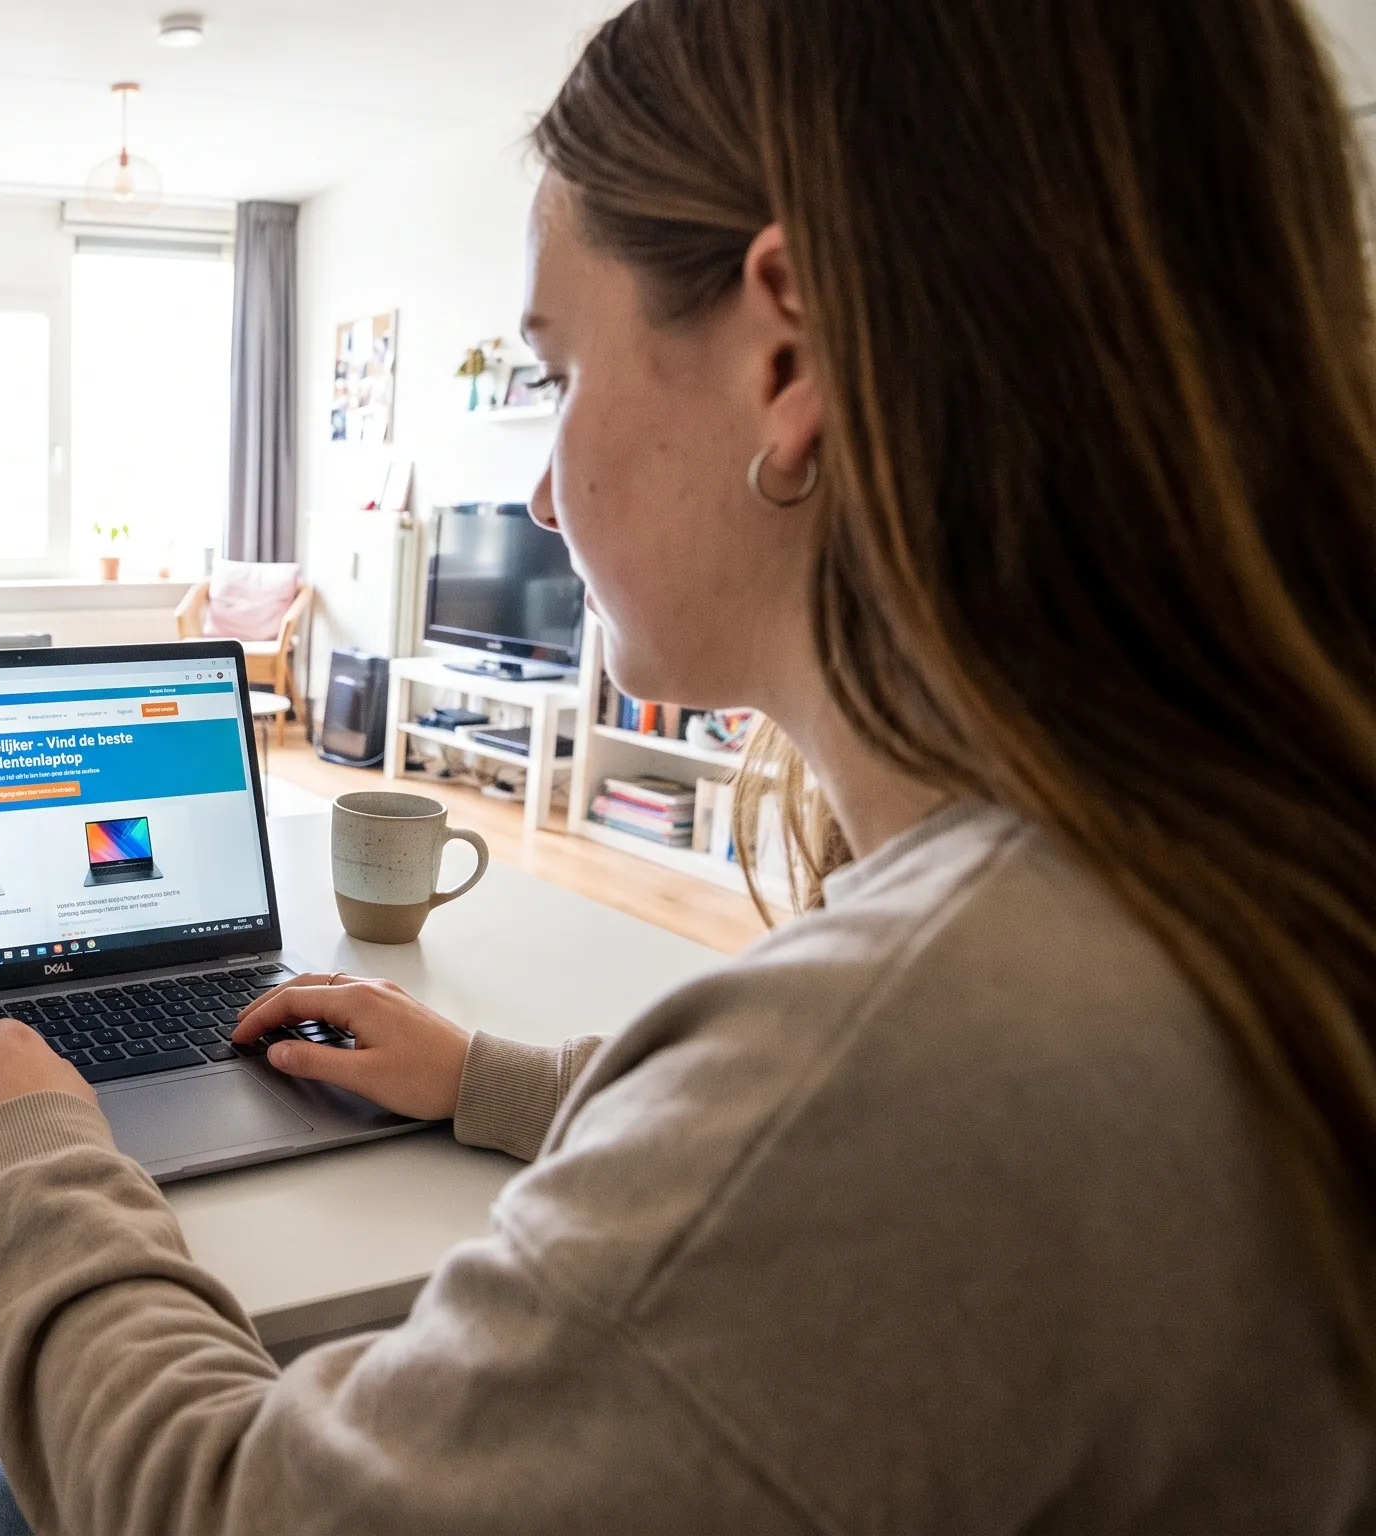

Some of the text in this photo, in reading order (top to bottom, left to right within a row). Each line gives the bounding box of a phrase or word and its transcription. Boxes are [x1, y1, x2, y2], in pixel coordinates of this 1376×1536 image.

[46, 735, 76, 749] Vind
[79, 735, 95, 747] de
[98, 732, 134, 746] beste
[44, 962, 74, 975] DELL
